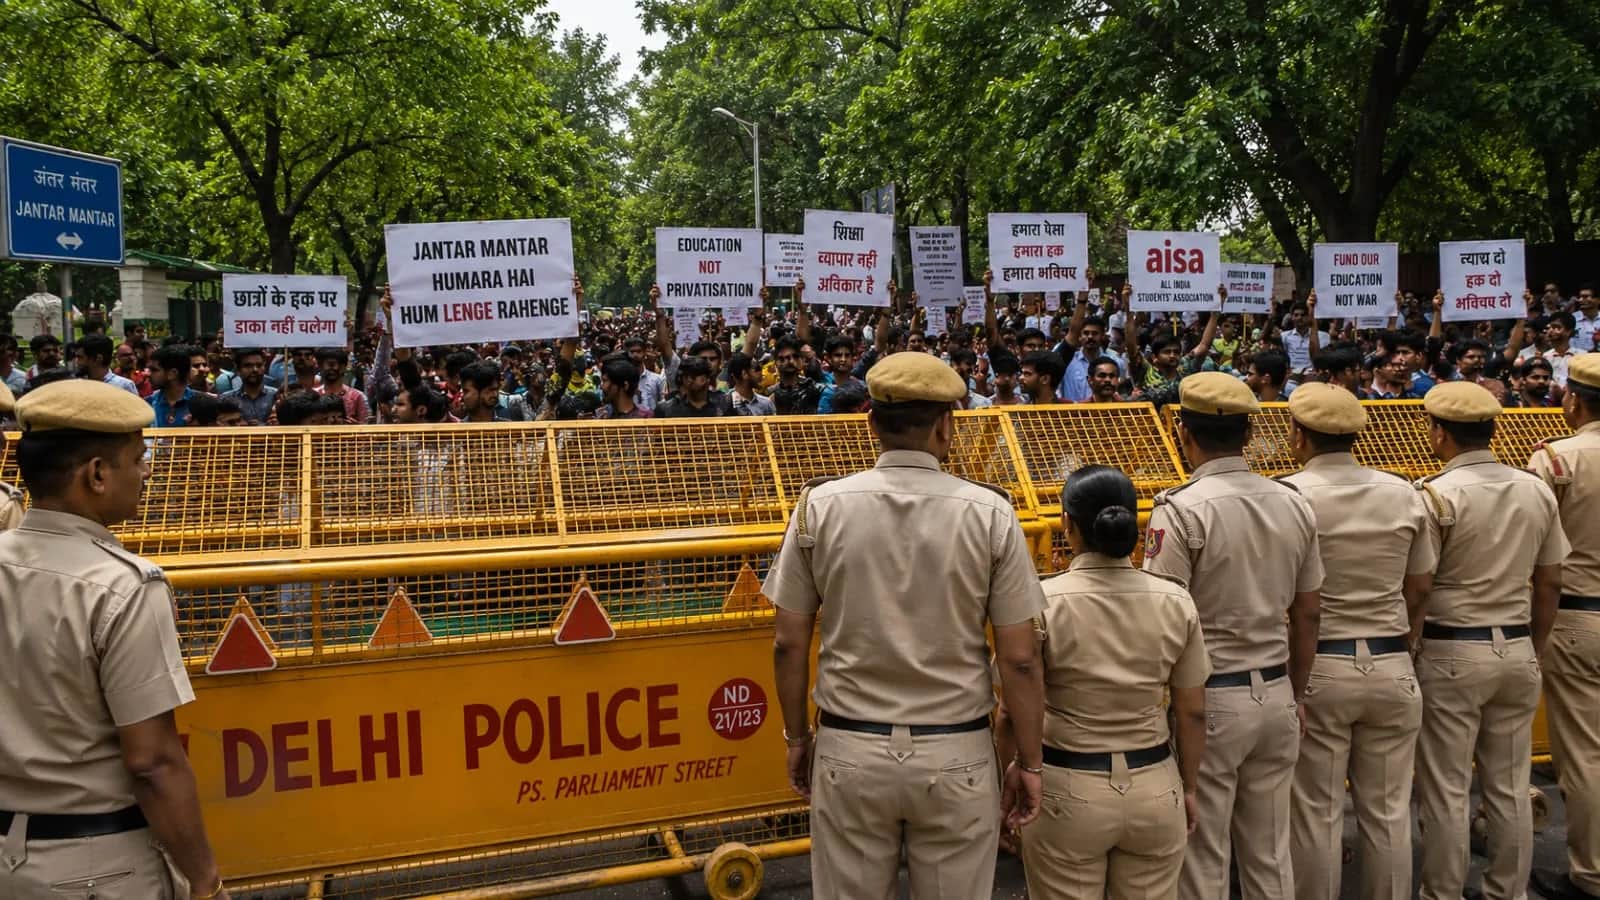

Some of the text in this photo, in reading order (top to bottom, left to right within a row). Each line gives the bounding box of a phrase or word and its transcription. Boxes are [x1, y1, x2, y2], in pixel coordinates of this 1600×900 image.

[33, 165, 98, 194] अंतर मंतर
[16, 199, 116, 228] JANTAR MANTAR
[1011, 224, 1041, 237] हमारा
[413, 237, 549, 261] JANTAR MANTAR
[677, 237, 742, 252] EDUCATION
[1013, 245, 1043, 259] हमारा
[817, 251, 855, 267] व्यापार
[1146, 239, 1204, 274] aisa
[1334, 253, 1379, 266] FUND OUR
[1493, 247, 1506, 265] दो
[698, 260, 721, 274] NOT
[1002, 267, 1034, 281] हमारा
[432, 268, 535, 291] HUMARA HAI
[1160, 279, 1191, 290] ALL INDIA
[1330, 273, 1382, 287] EDUCATION
[1488, 270, 1502, 287] दो
[233, 285, 268, 307] छात्रों
[271, 285, 287, 307] के
[318, 291, 338, 307] पर
[666, 282, 753, 297] PRIVATISATION
[1173, 293, 1214, 303] ASSOCIATION
[1335, 294, 1377, 306] NOT WAR
[1499, 291, 1512, 308] दो
[400, 297, 569, 324] HUM LENGE RAHENGE
[234, 315, 337, 334] डाका नहीं चलेगा
[723, 685, 751, 705] ND
[714, 708, 762, 734] 21/123
[222, 683, 681, 798] DELHI POLICE
[516, 755, 738, 804] PS. PARLIAMENT STREET
